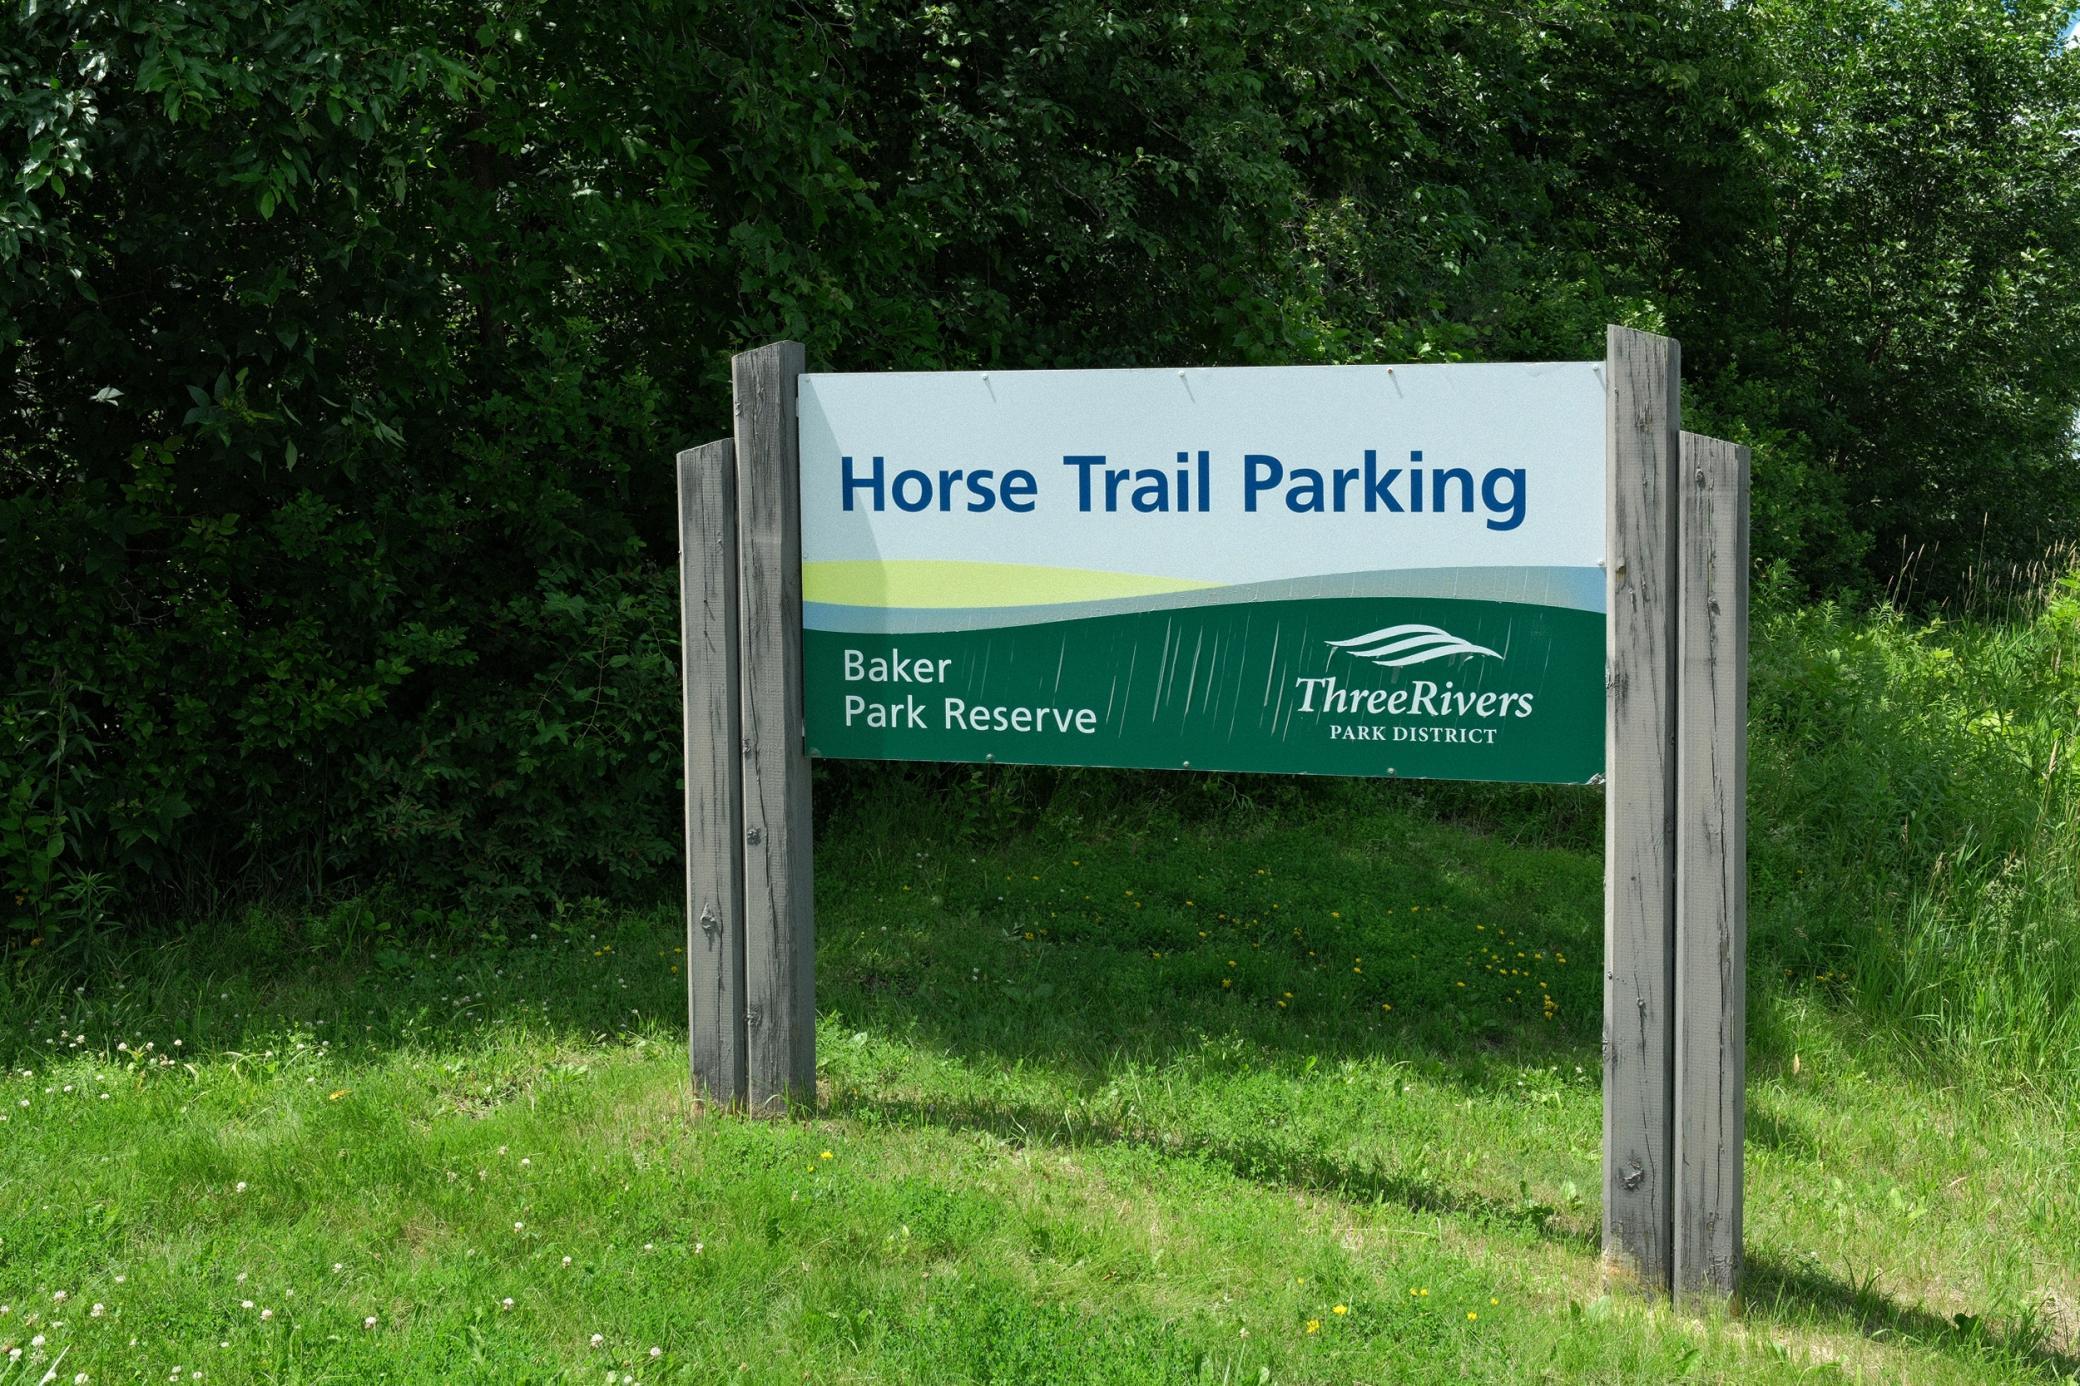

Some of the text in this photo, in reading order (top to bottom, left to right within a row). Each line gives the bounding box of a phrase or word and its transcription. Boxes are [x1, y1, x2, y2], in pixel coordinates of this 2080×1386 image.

[841, 449, 1527, 532] Horse Trail Parking
[844, 649, 953, 683] Baker
[845, 694, 1098, 734] Park Reserve
[1329, 725, 1498, 744] PARK DISTRICT
